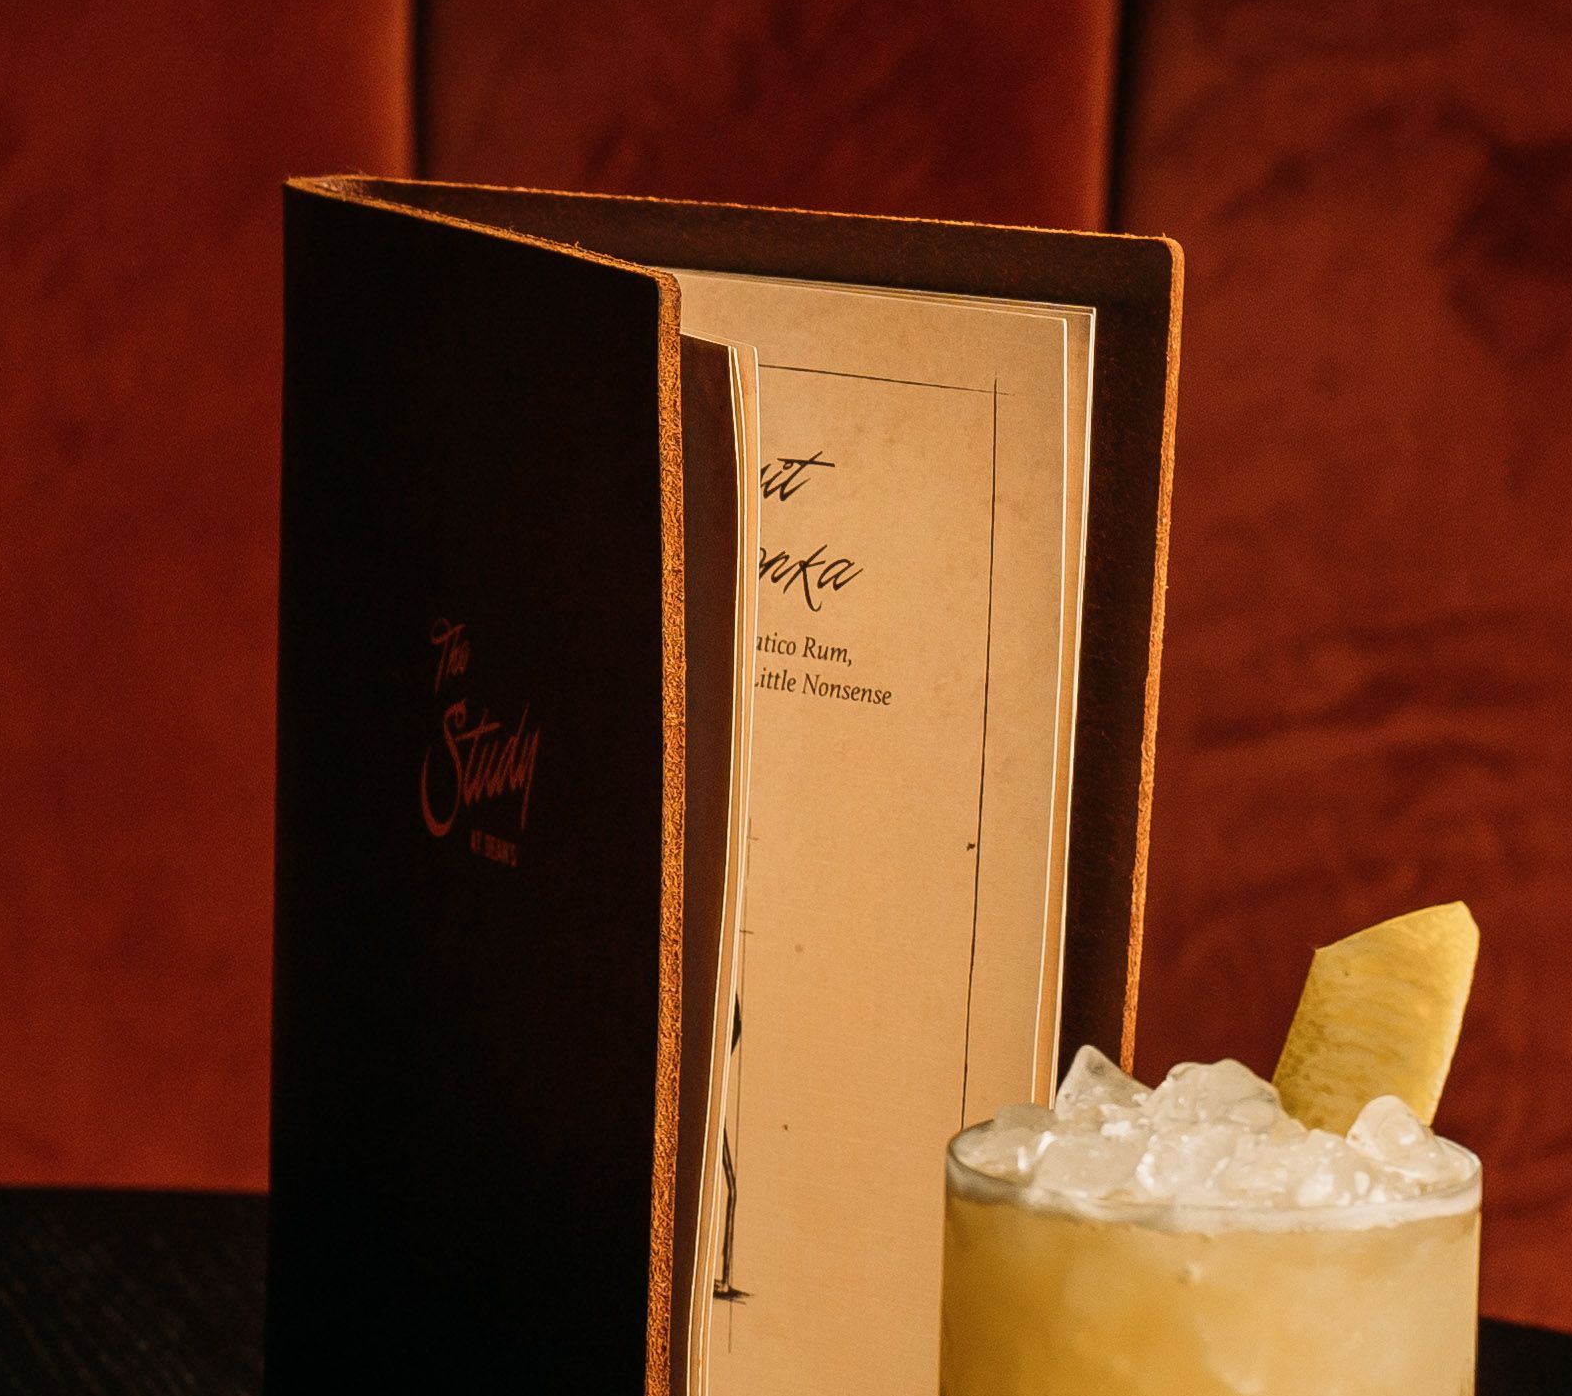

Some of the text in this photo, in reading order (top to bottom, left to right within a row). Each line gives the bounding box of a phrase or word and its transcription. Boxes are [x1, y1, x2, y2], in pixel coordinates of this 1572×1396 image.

[431, 617, 470, 698] The
[802, 635, 852, 667] Rum,
[754, 667, 892, 705] ittle Nonsense
[421, 698, 540, 837] Study
